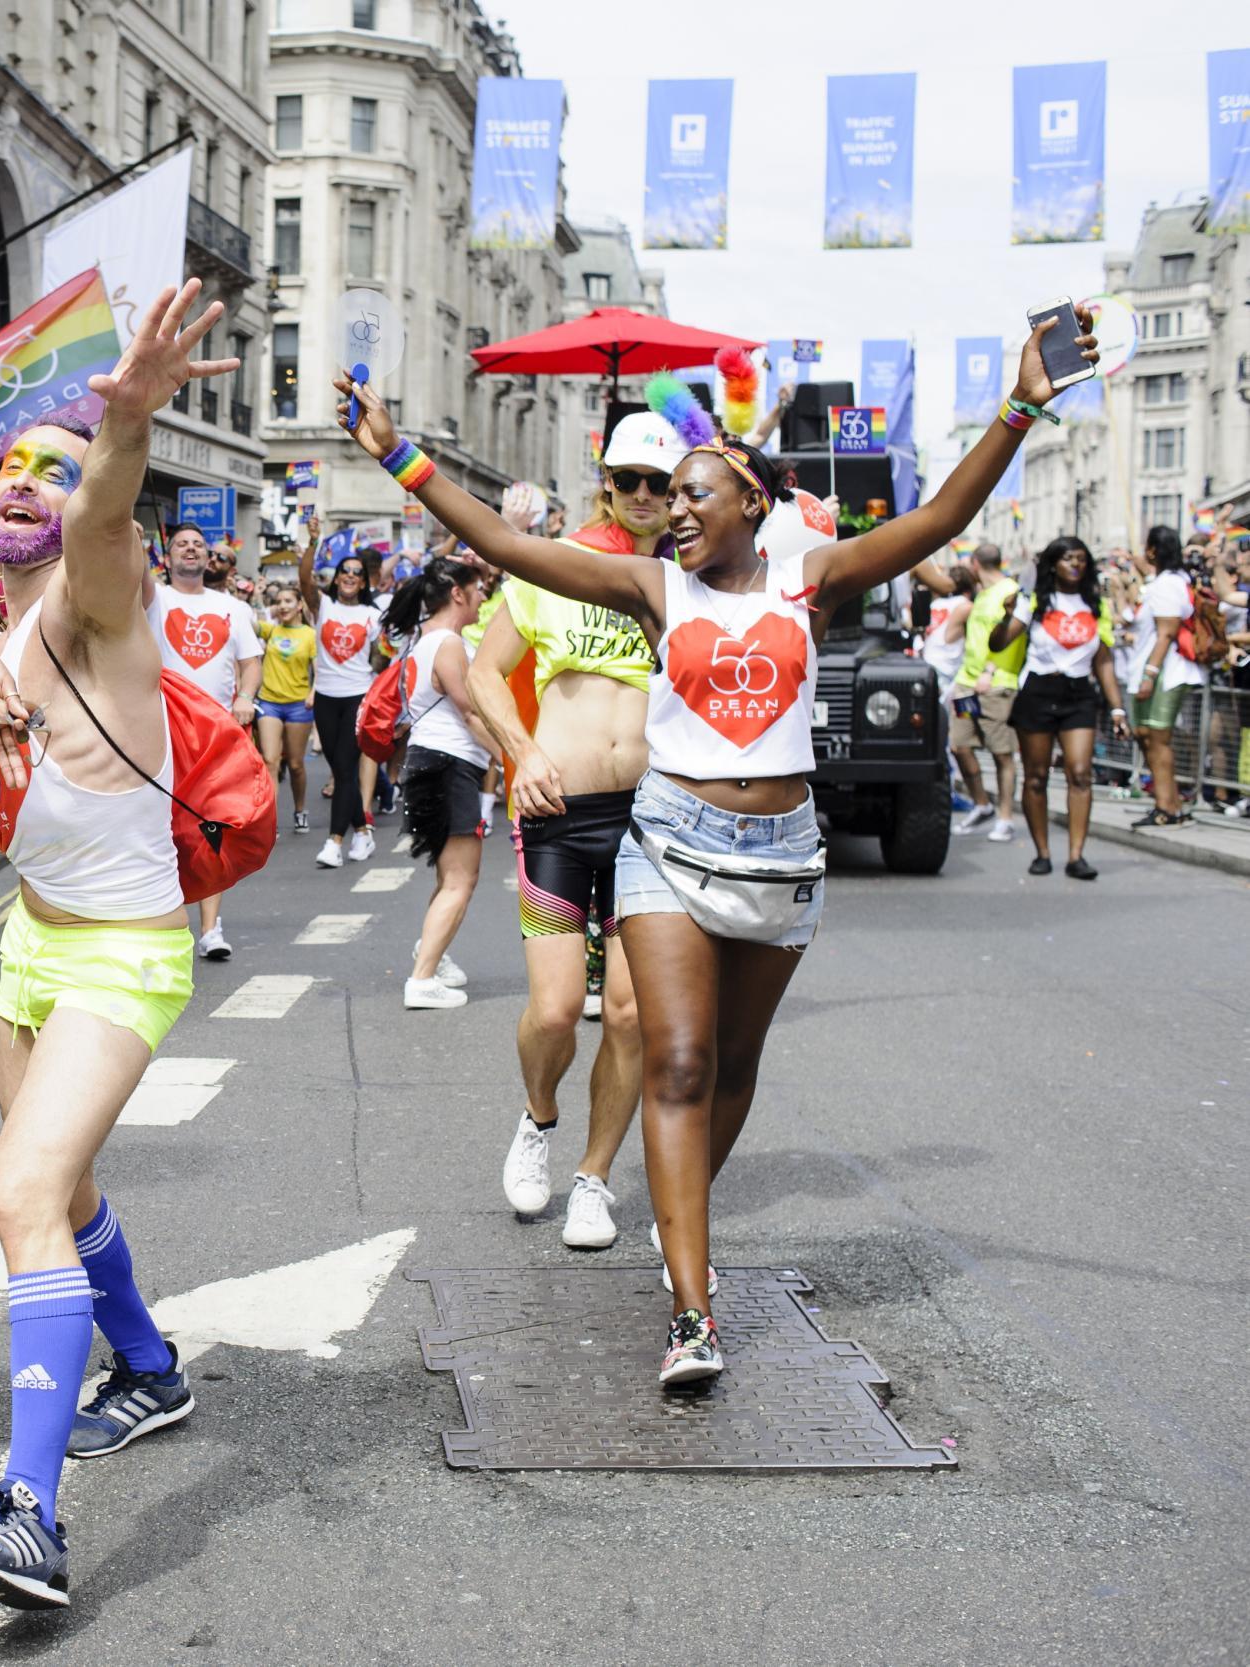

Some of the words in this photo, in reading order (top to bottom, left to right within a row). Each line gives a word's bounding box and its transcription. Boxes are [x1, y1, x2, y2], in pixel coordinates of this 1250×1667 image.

[485, 119, 551, 134] SUMMER
[841, 411, 868, 439] 56
[182, 618, 213, 648] 56
[566, 629, 655, 665] STEWAR
[708, 636, 778, 695] 56
[709, 699, 779, 710] DEAN
[709, 709, 779, 719] STREET
[11, 1377, 59, 1391] adidas
